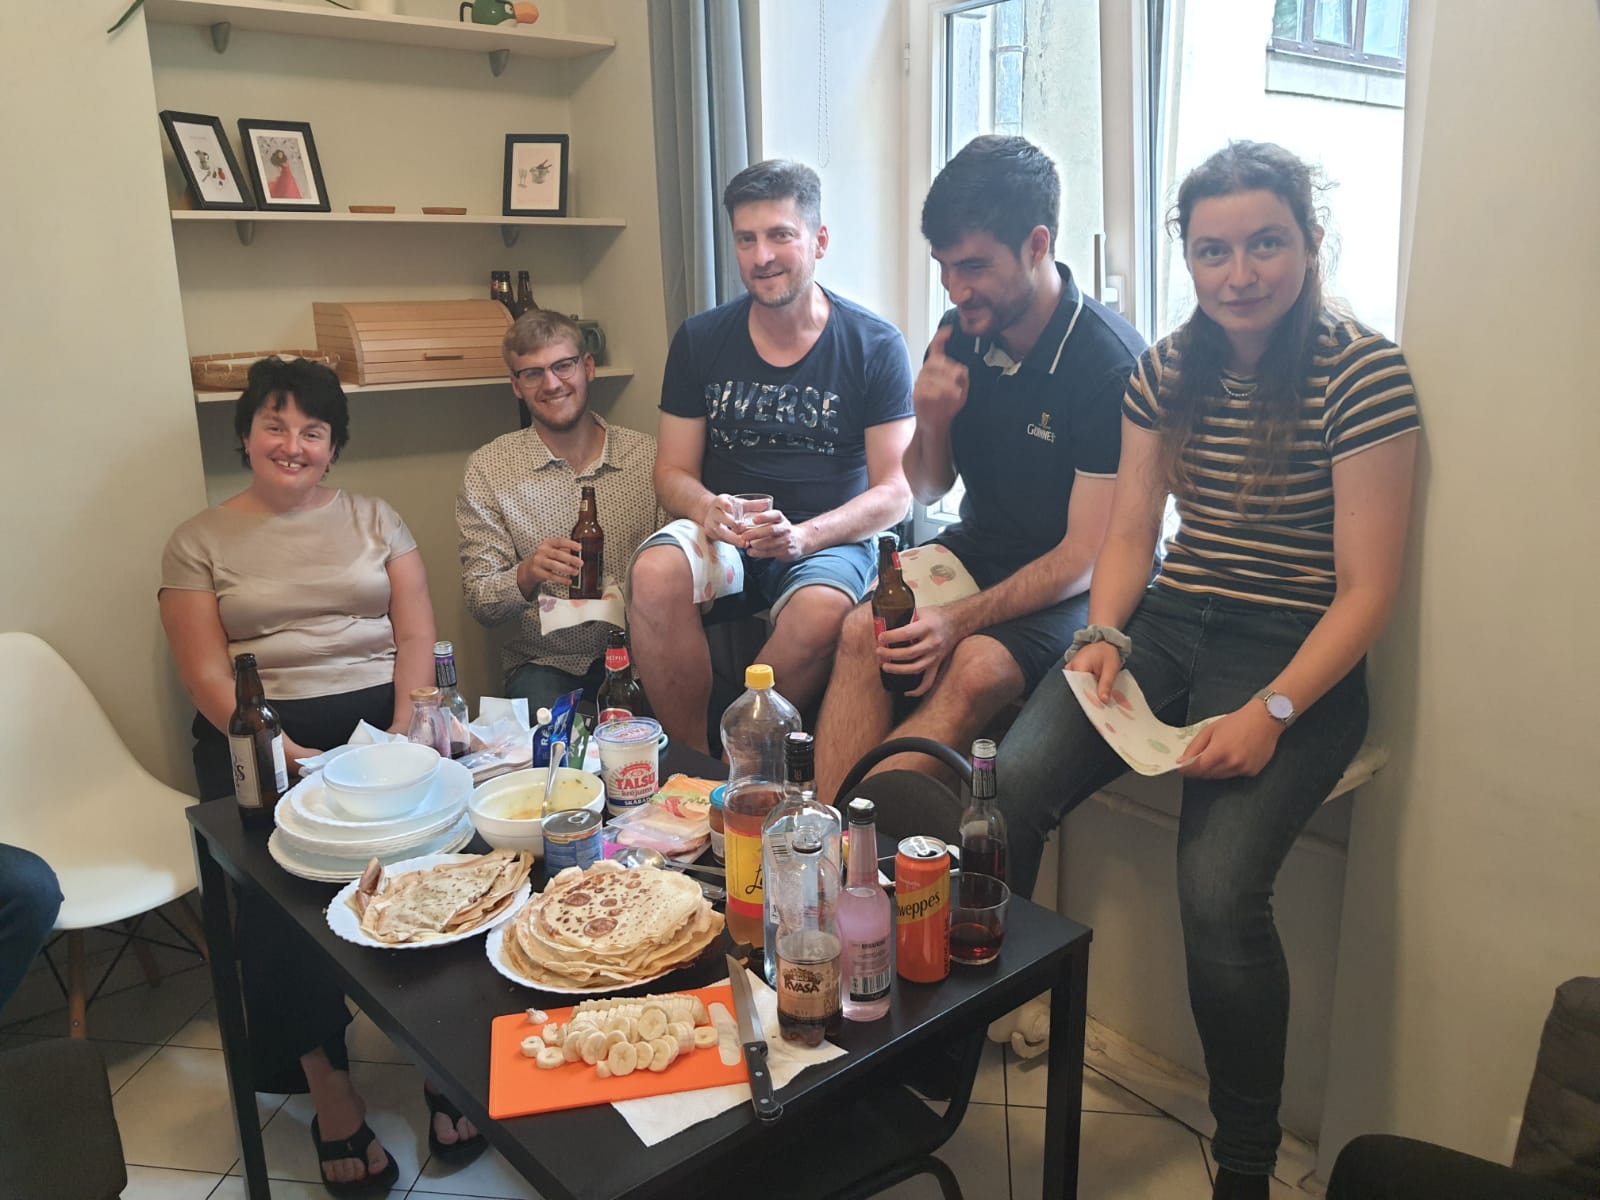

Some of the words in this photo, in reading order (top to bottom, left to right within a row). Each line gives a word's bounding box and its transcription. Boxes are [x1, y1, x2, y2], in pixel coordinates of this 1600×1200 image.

[615, 771, 656, 790] TALSU
[897, 891, 941, 920] weppes
[784, 979, 820, 993] KVASA
